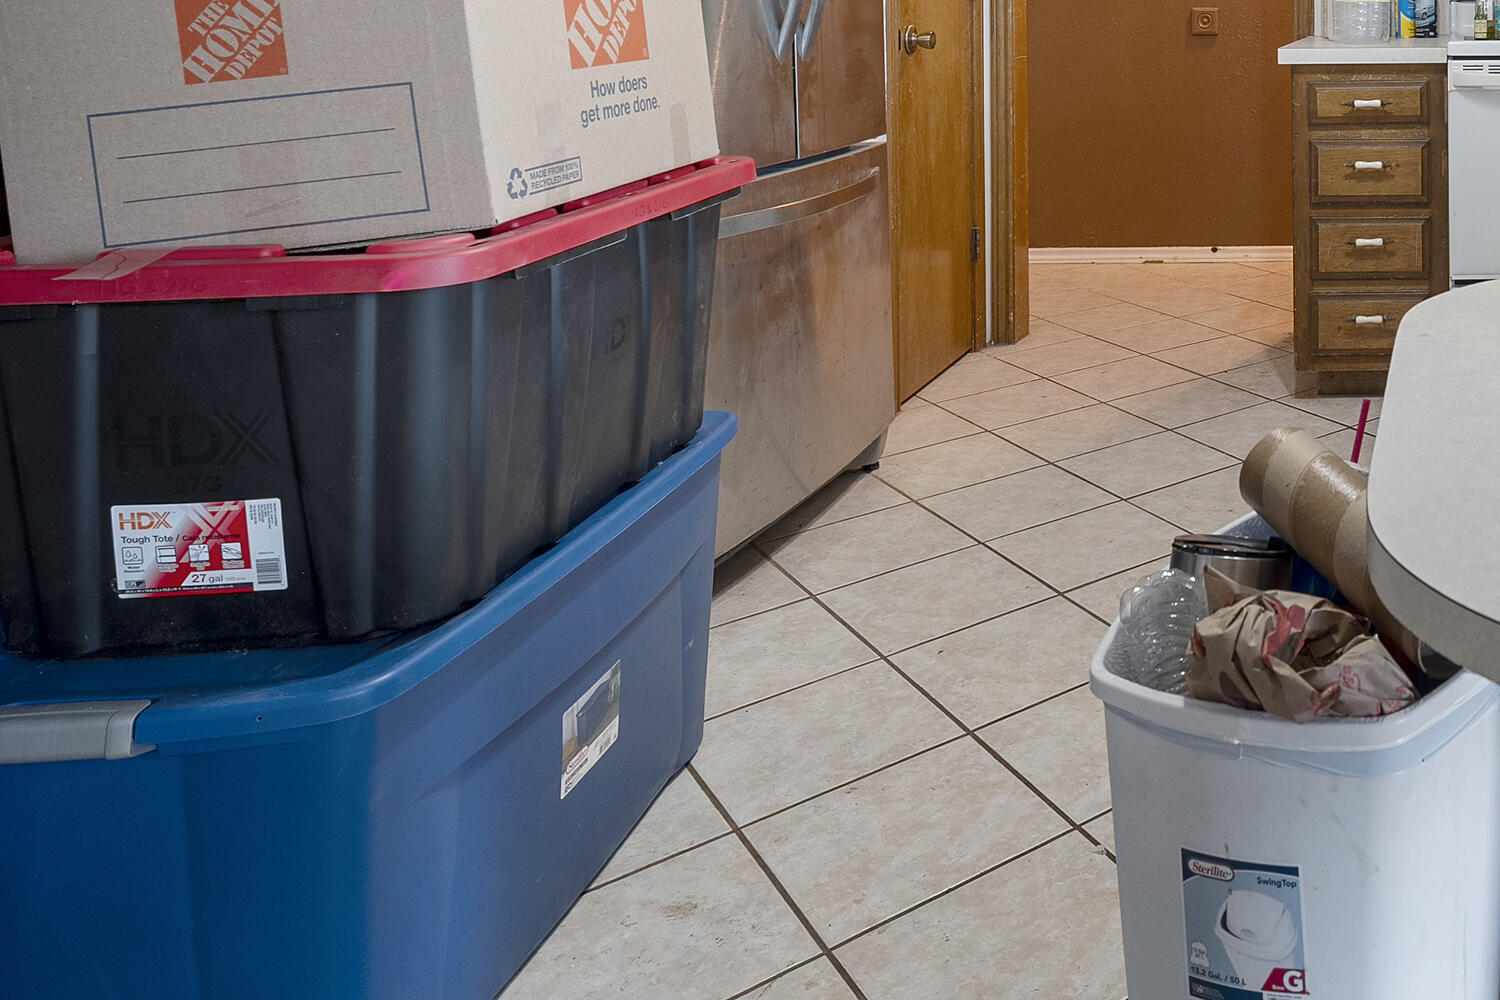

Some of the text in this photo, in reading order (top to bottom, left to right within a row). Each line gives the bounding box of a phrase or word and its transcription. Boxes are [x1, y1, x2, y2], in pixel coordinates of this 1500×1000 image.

[224, 17, 282, 80] DEPOT
[590, 76, 647, 98] How doers
[580, 96, 660, 128] get more done.
[530, 168, 547, 180] MADE
[547, 165, 564, 176] FROM
[531, 170, 580, 190] RECYCLED PAPER
[112, 408, 280, 470] HDX
[119, 511, 172, 530] HDX
[121, 535, 150, 545] Tough
[152, 534, 173, 543] Tote
[191, 574, 206, 583] 27
[208, 575, 224, 584] gal
[1192, 861, 1228, 879] Sterilite
[1256, 877, 1297, 888] SwingTop
[1190, 966, 1206, 976] 13.2
[1207, 971, 1222, 981] Gal.
[1229, 976, 1241, 985] 50
[1282, 970, 1304, 993] G
